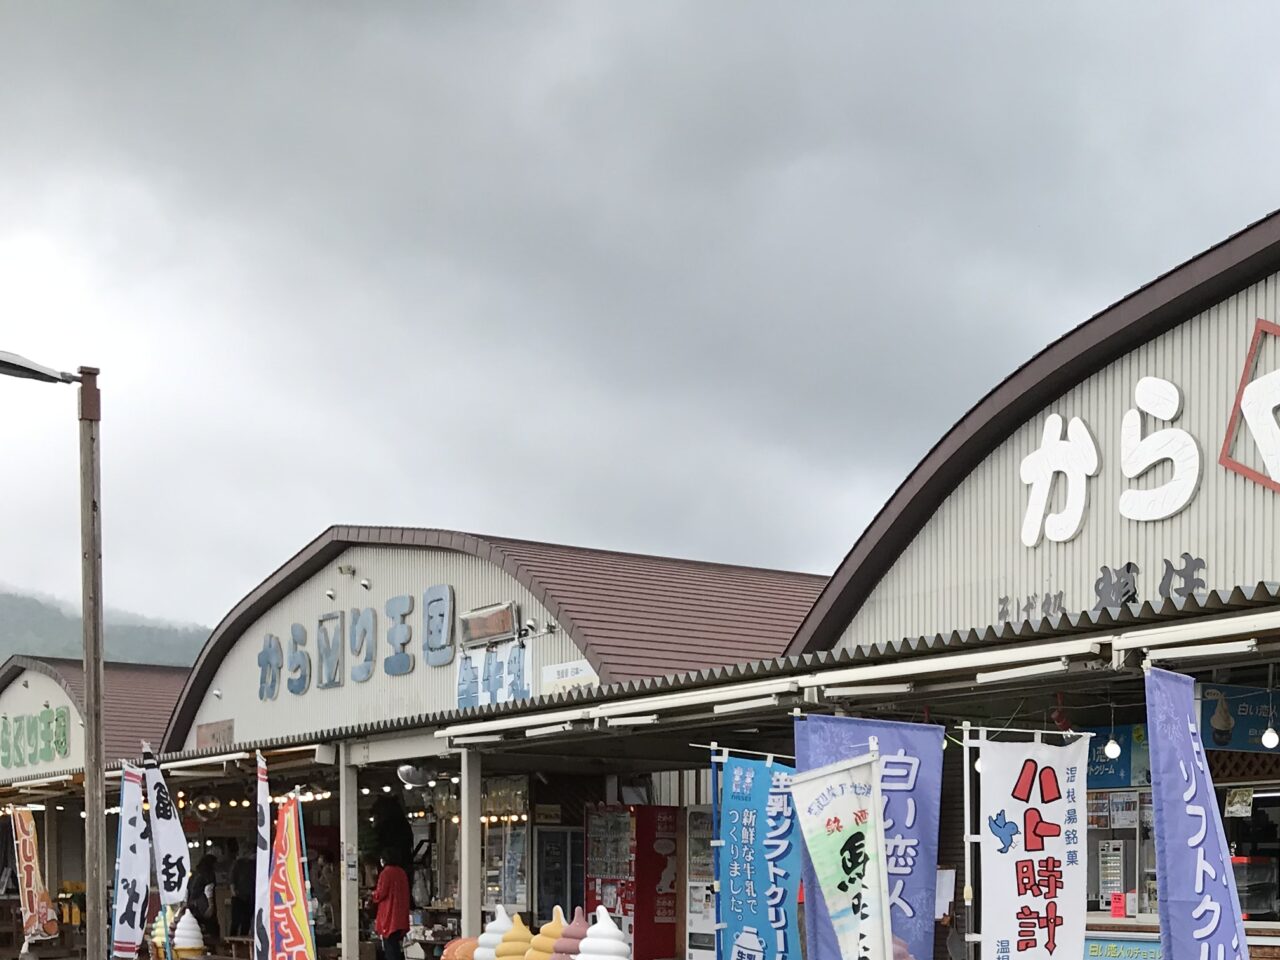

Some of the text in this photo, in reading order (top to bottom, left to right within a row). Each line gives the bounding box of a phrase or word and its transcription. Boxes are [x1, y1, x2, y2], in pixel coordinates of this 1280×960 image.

[728, 809, 744, 922] つくりました。
[741, 808, 757, 914] 新鮮な牛乳で
[1064, 766, 1080, 867] 温根湯銘菓
